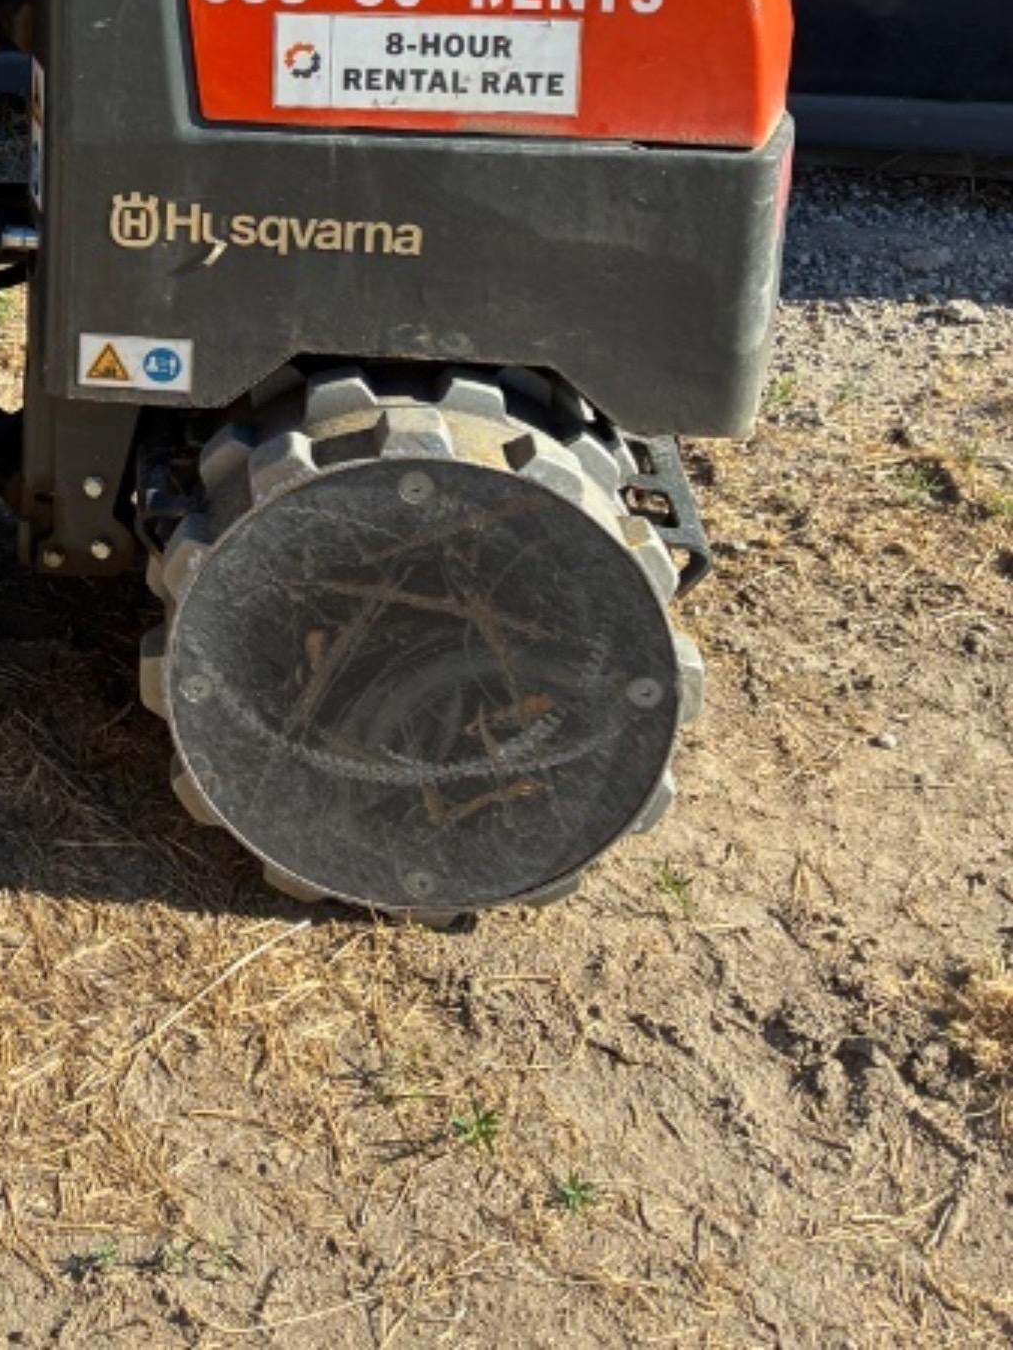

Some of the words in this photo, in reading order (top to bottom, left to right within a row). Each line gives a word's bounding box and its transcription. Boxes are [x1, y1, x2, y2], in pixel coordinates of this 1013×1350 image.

[385, 32, 513, 59] 8-HOUR
[342, 68, 471, 95] RENTAL
[480, 72, 565, 97] RATE
